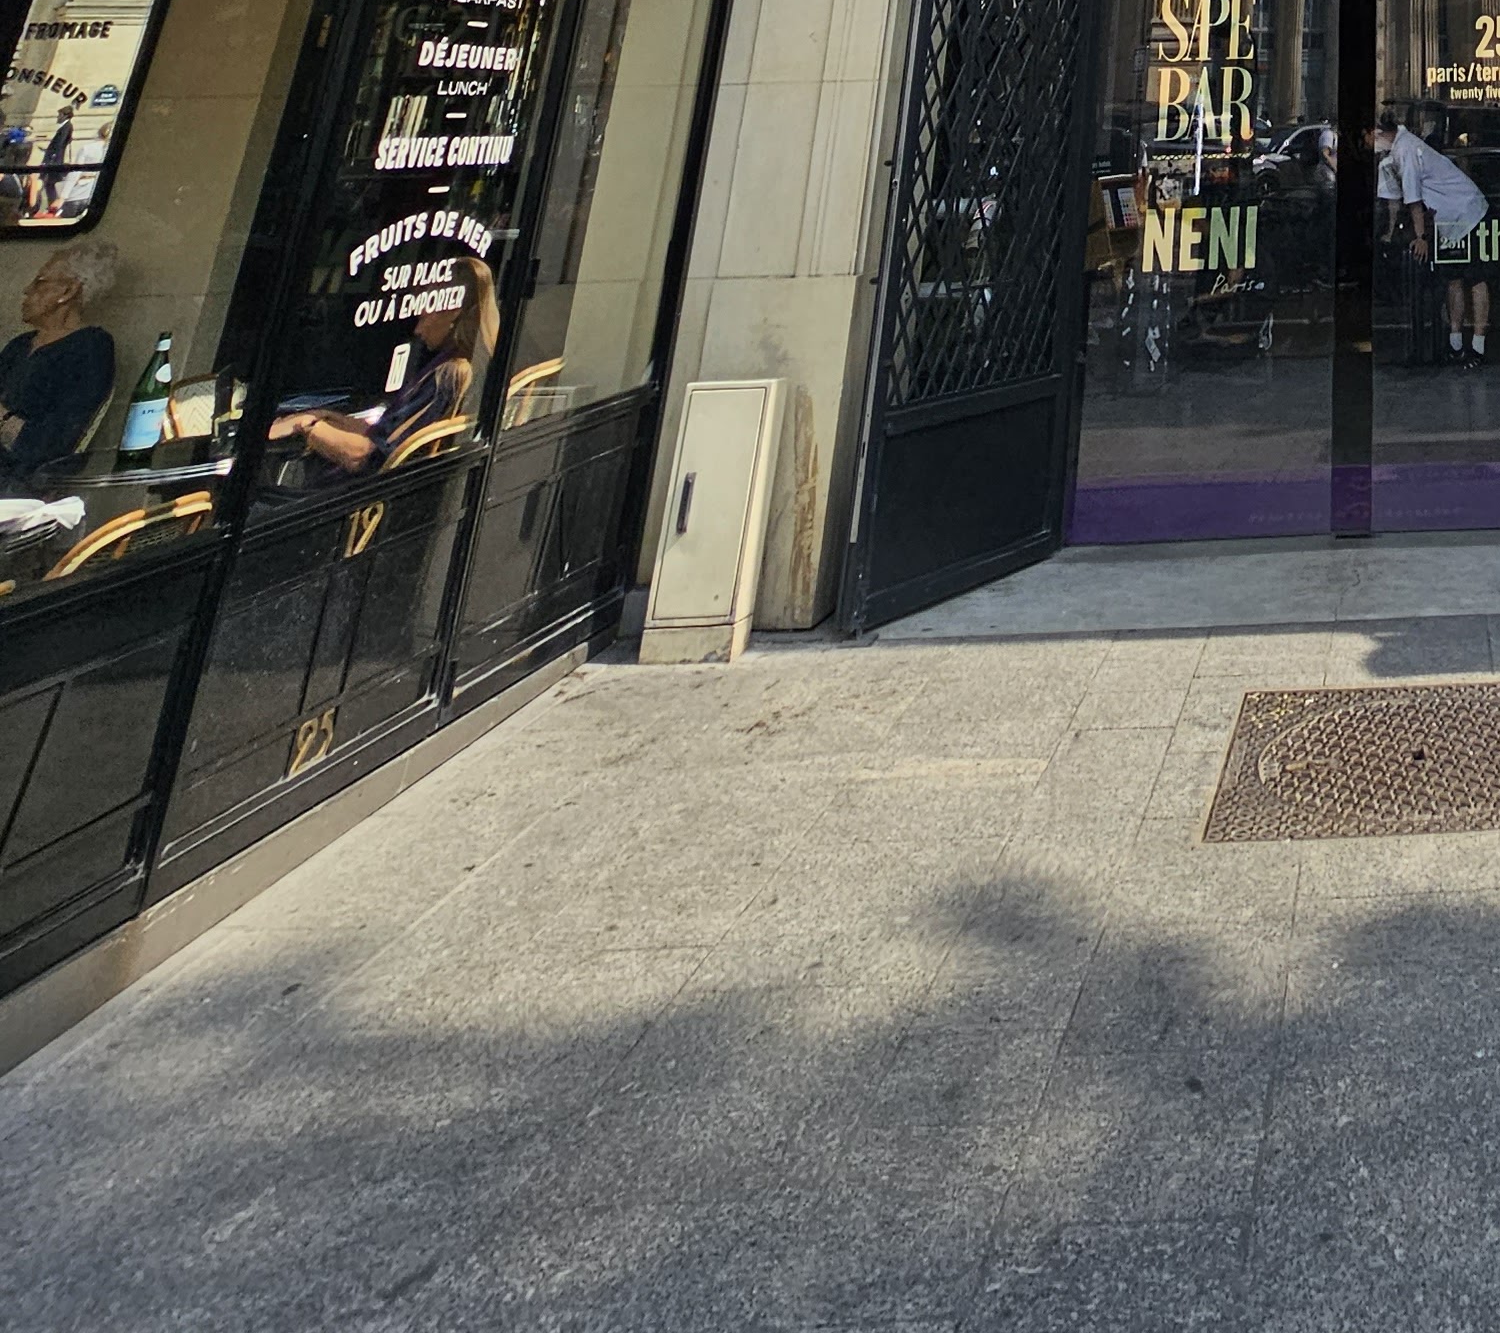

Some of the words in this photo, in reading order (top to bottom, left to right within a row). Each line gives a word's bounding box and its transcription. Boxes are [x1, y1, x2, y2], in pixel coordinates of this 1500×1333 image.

[25, 20, 113, 40] FROMAGE
[418, 36, 521, 71] DÉJEUNER
[437, 80, 490, 96] LUNCH
[1153, 66, 1255, 145] BAR
[1450, 86, 1483, 102] twenty
[374, 136, 448, 171] SERVICE
[446, 135, 514, 167] CONTINU
[350, 212, 428, 277] FRUITS
[430, 210, 459, 238] DE
[457, 215, 493, 259] MER
[1142, 205, 1258, 272] NENI
[381, 266, 412, 293] SUR
[412, 257, 457, 287] PLACE
[354, 298, 383, 328] OU
[383, 294, 397, 323] À
[399, 284, 466, 320] EMPORTER
[344, 501, 385, 559] 19
